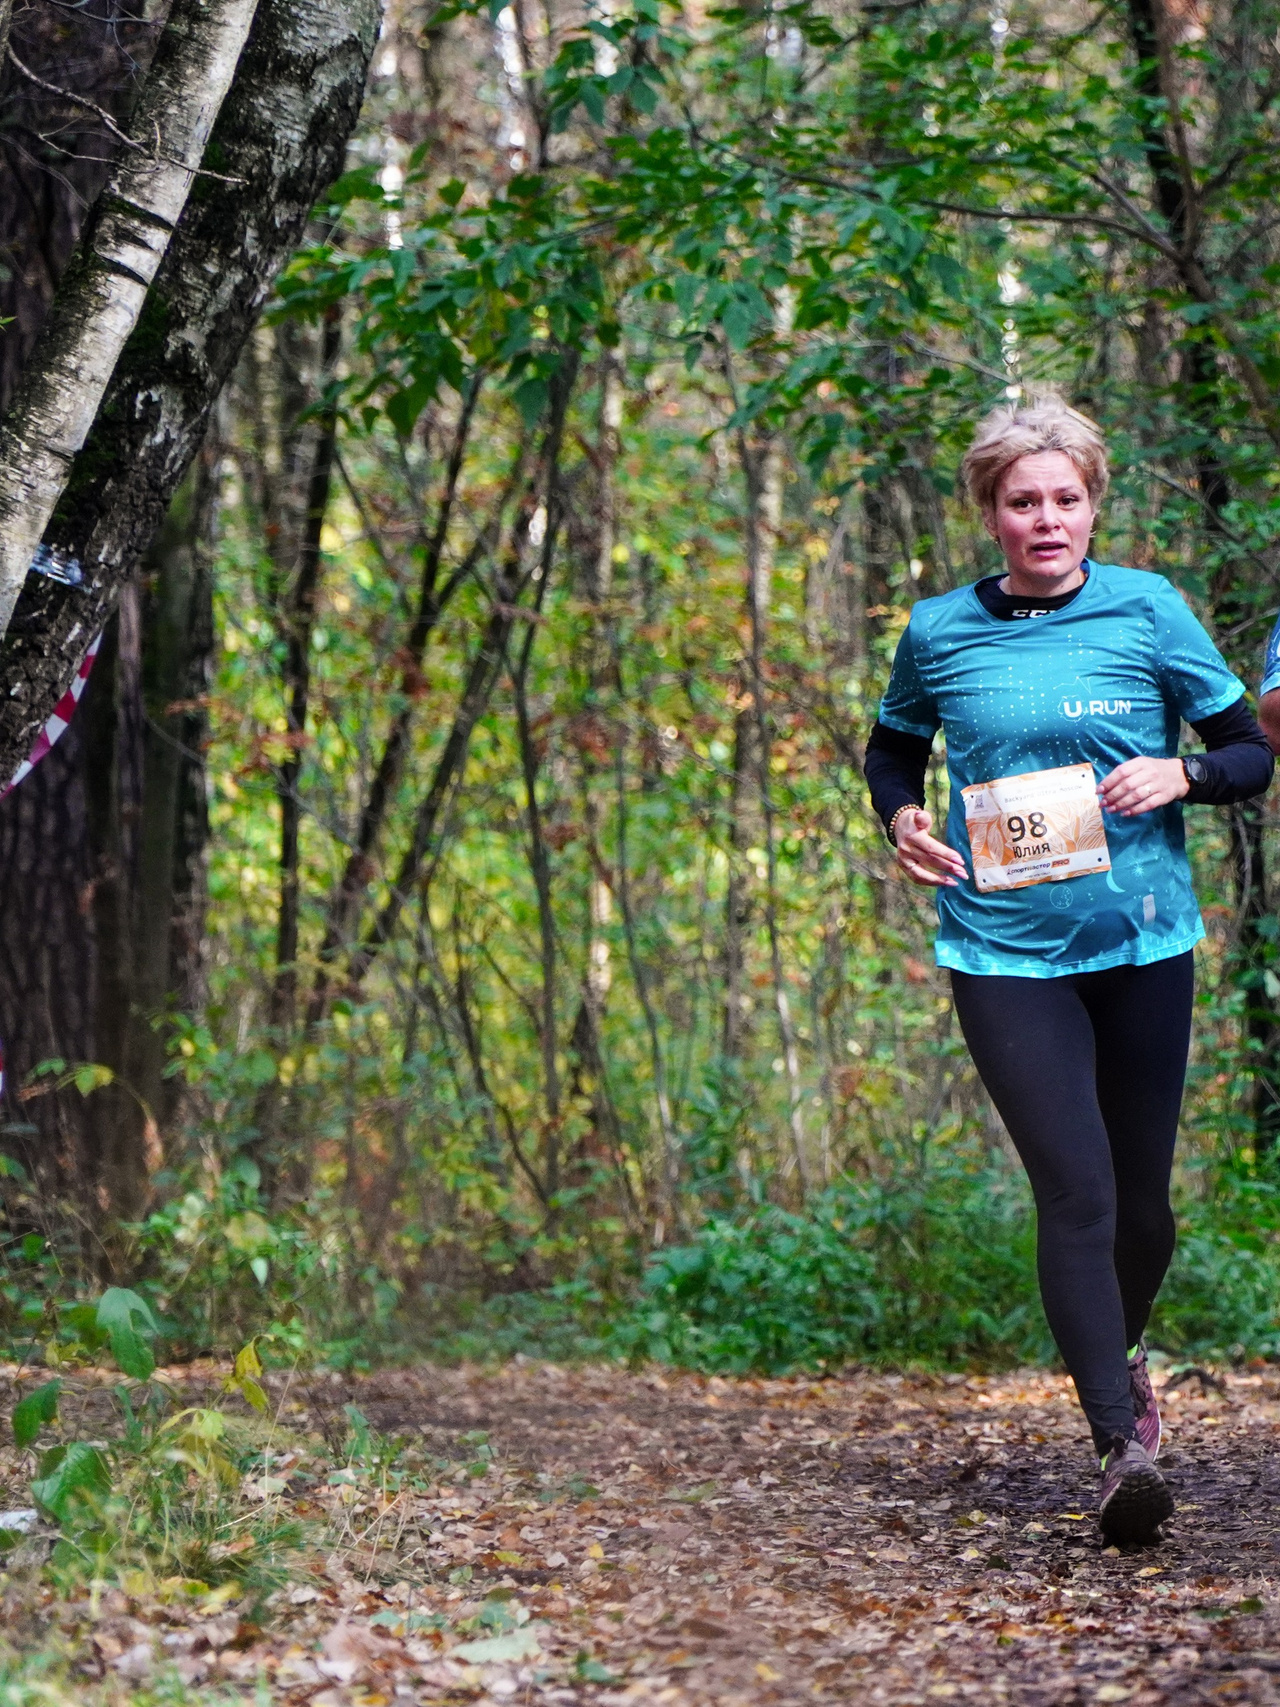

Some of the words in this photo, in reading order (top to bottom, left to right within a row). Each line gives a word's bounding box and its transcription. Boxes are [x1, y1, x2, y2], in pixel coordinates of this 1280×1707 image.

[1012, 609, 1056, 618] CC
[1063, 701, 1083, 718] U
[1089, 699, 1132, 716] RUN
[1004, 792, 1034, 804] Backyard
[1007, 811, 1048, 843] 98
[1013, 842, 1051, 859] Юлия
[1052, 858, 1070, 867] PRO
